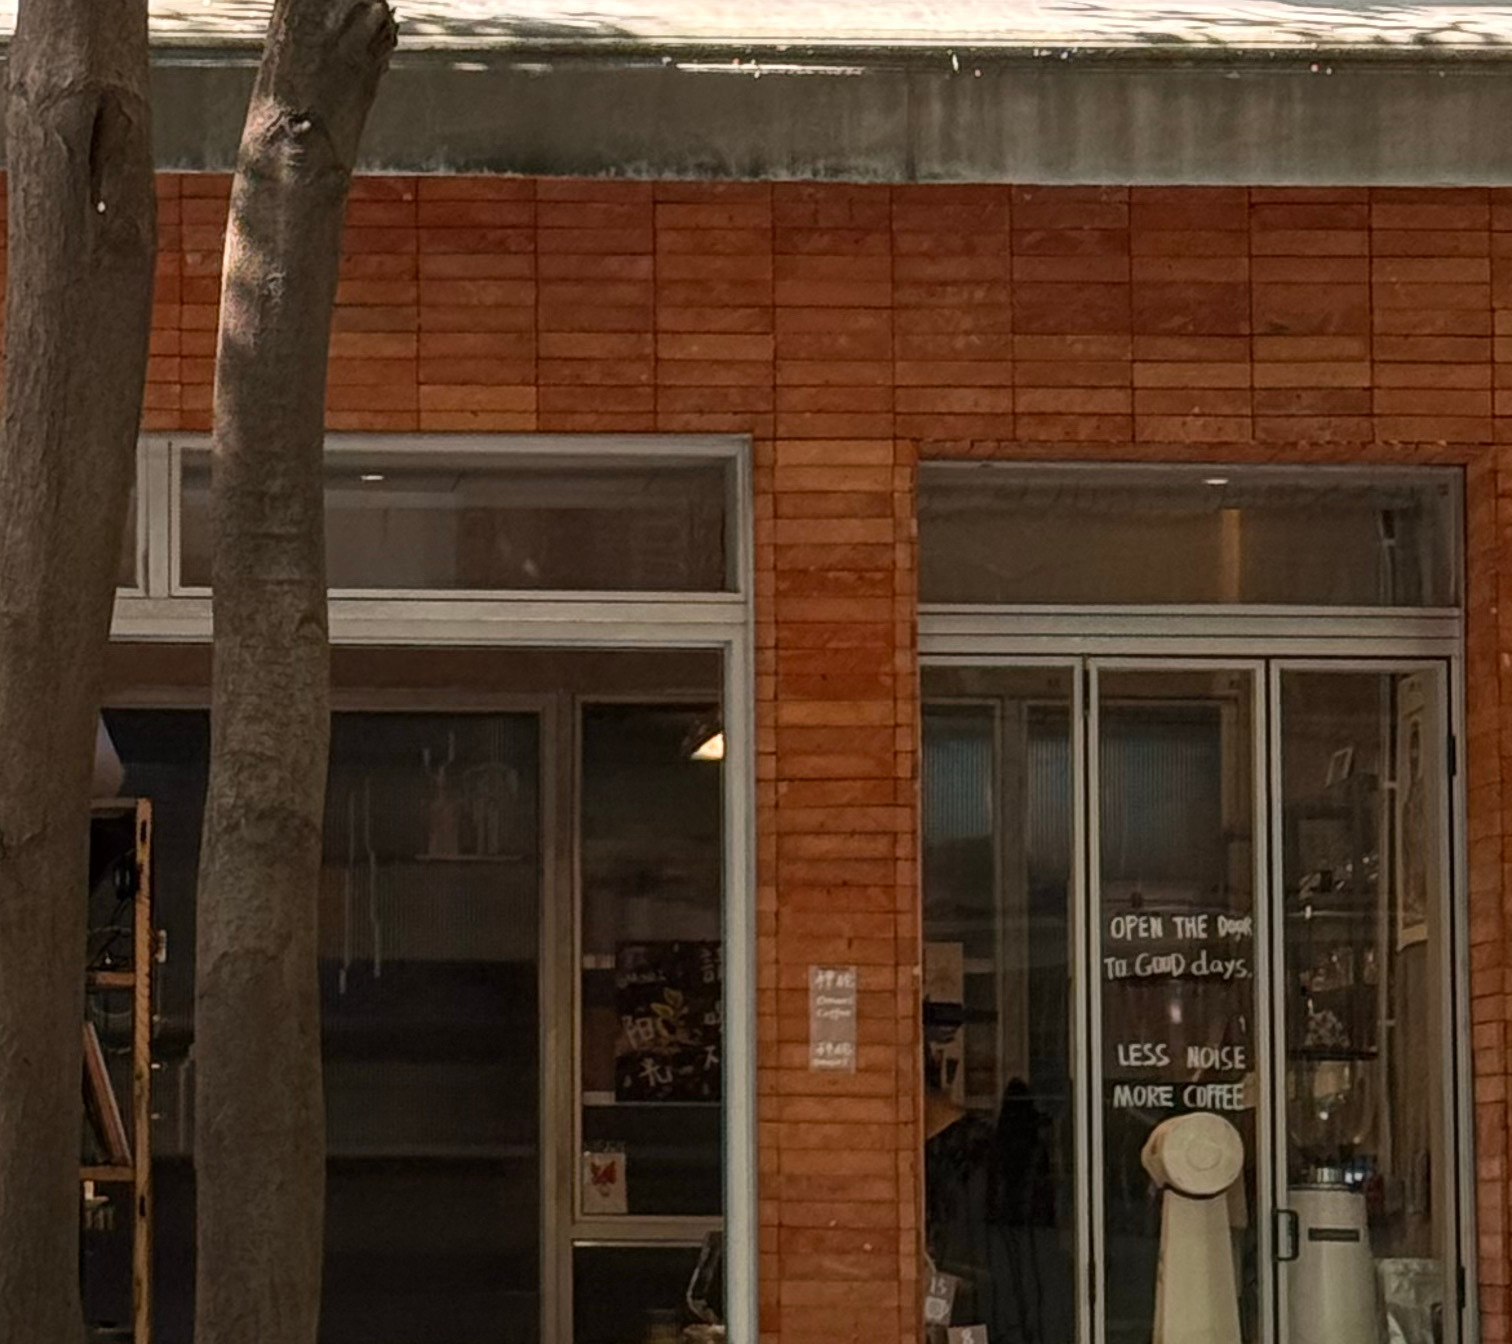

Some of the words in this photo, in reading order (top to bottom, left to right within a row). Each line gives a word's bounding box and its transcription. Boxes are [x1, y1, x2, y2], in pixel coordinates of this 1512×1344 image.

[1110, 915, 1163, 941] OPEN
[1172, 914, 1208, 939] THE
[1135, 953, 1185, 977] GOOD
[1117, 1043, 1171, 1067] LESS
[1113, 1084, 1174, 1108] MORE
[1183, 1083, 1245, 1110] COFFEE
